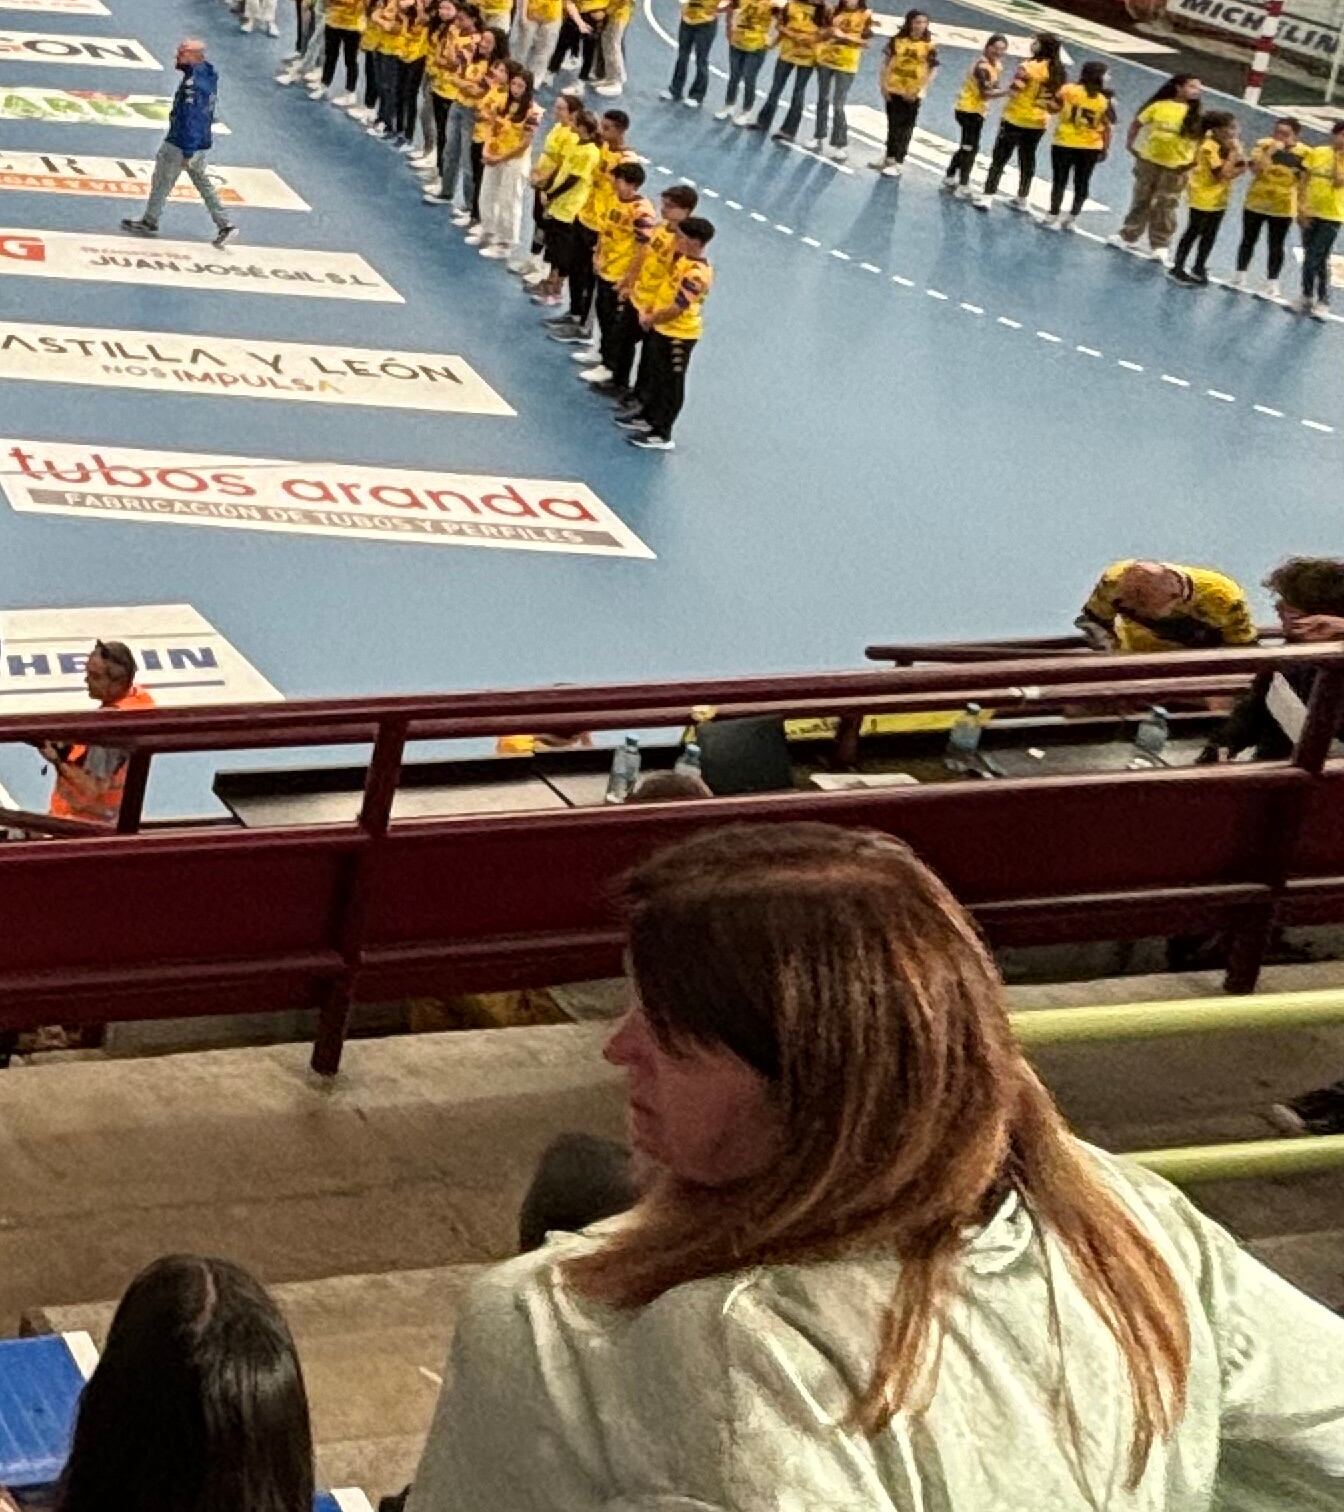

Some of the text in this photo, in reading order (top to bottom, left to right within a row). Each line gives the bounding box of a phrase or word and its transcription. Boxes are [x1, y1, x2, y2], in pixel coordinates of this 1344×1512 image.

[89, 256, 180, 274] JUAN
[186, 259, 268, 280] JOSÉ
[172, 368, 344, 396] IMPULSA
[248, 352, 284, 376] Y
[311, 350, 466, 388] LEÓN
[10, 445, 598, 525] tubos aranda
[63, 490, 585, 545] FABRICACIÓN DE TUBOS Y PERFILES
[6, 646, 218, 677] HEIN
